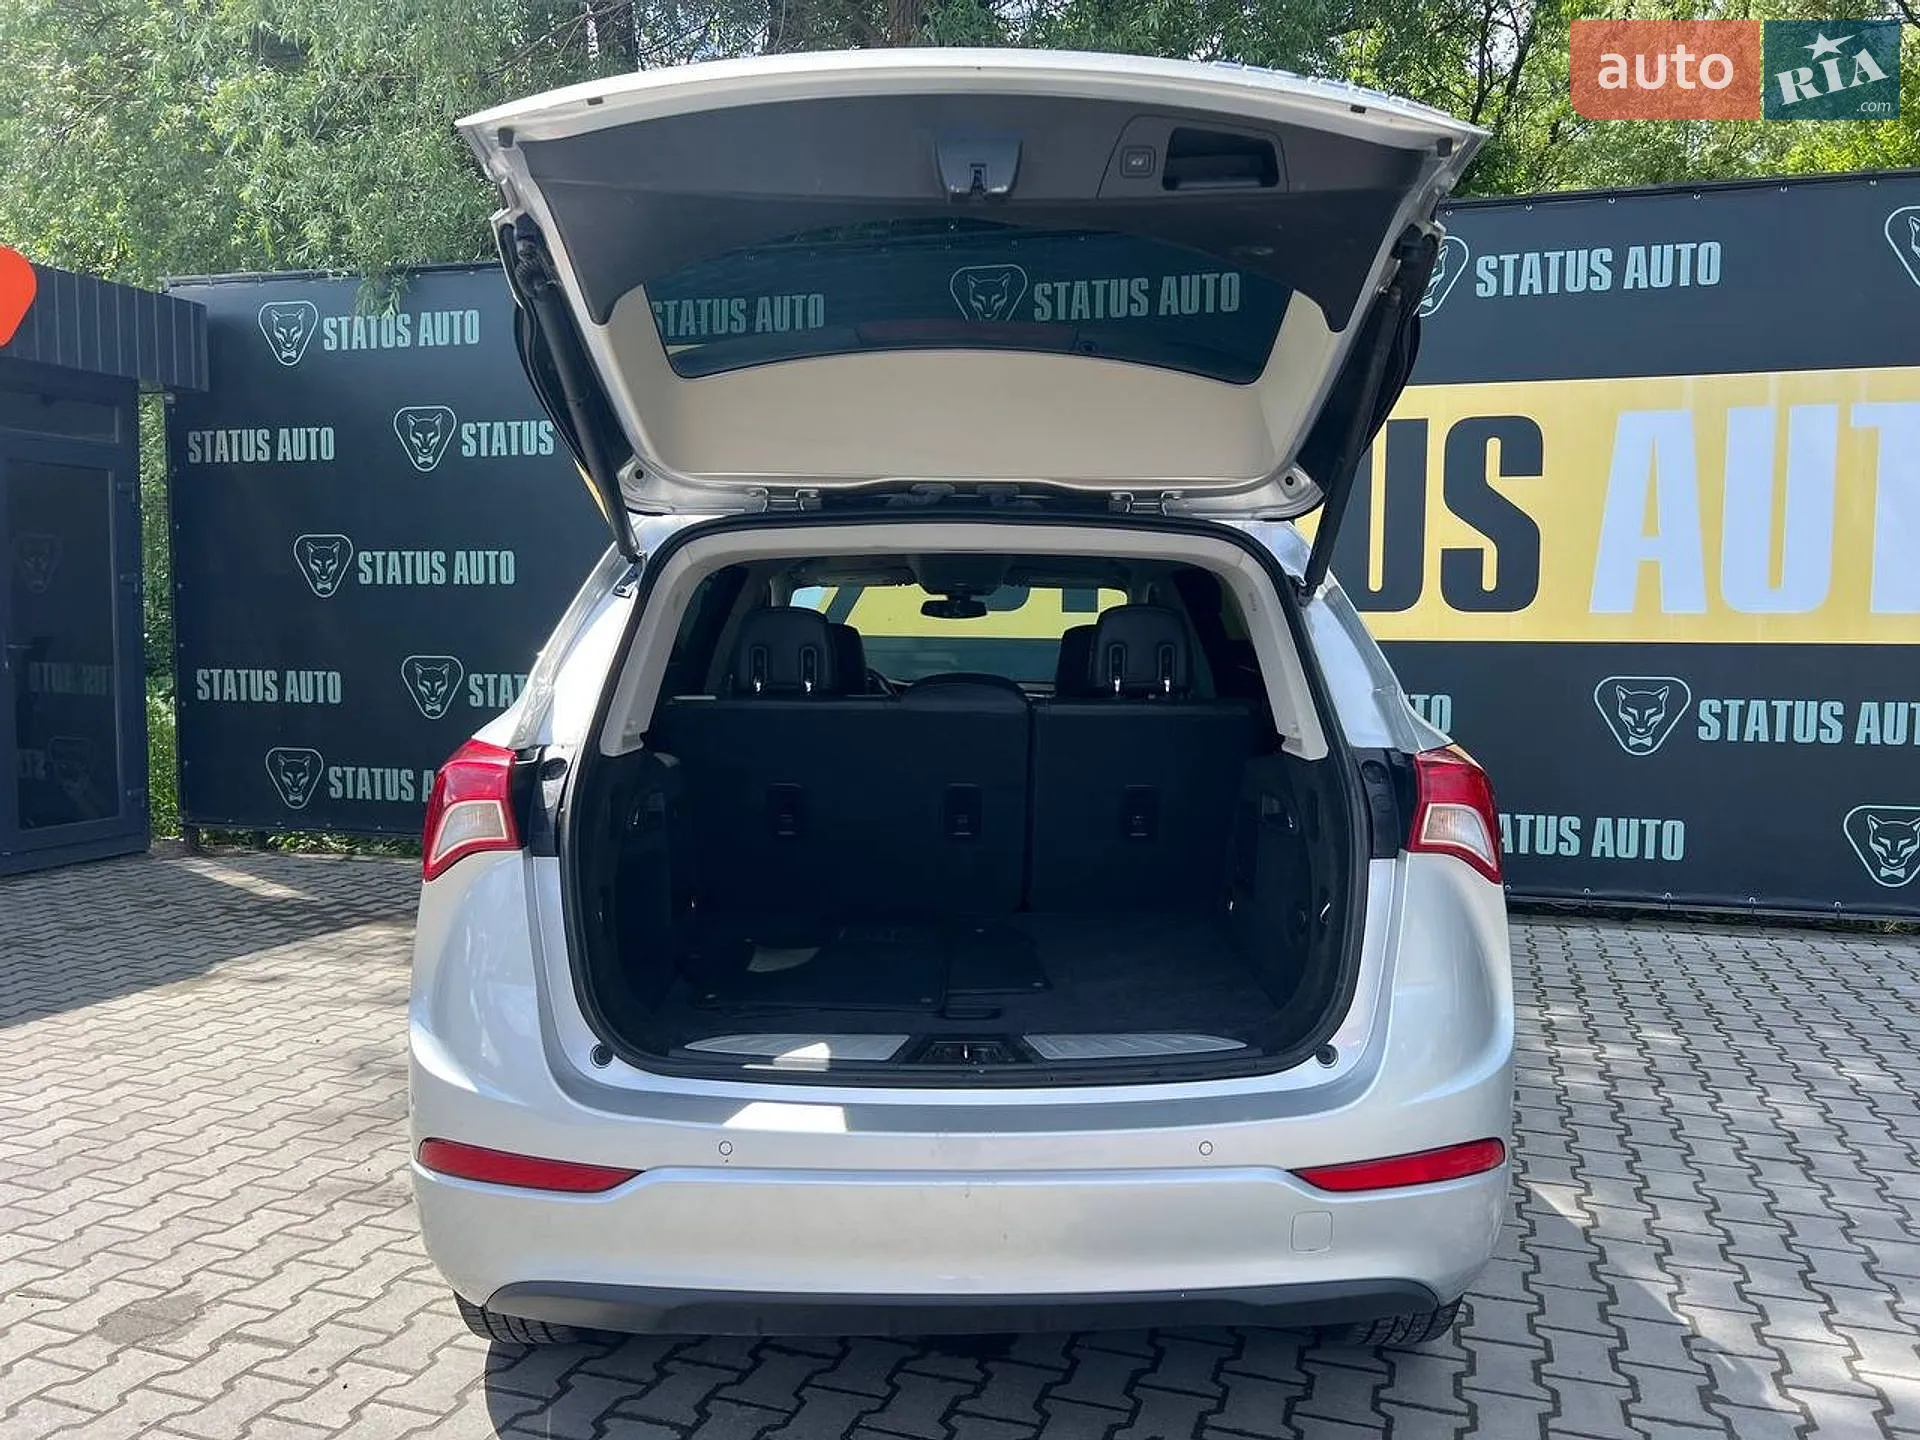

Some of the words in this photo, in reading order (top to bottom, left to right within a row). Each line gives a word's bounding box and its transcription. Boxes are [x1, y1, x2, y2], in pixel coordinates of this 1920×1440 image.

[1475, 247, 1613, 298] STATUS
[1623, 241, 1722, 290] AUTO
[754, 293, 825, 333] AUTO
[1034, 277, 1149, 322] STATUS
[1158, 272, 1241, 316] AUTO
[323, 313, 412, 351] STATUS
[418, 309, 480, 347] AUTO
[188, 428, 271, 464] STATUS
[277, 426, 335, 462] AUTO
[461, 420, 555, 458] STATUS
[358, 550, 447, 585] STATUS
[453, 550, 515, 585] AUTO
[196, 668, 279, 703] STATUS
[284, 670, 342, 705] AUTO
[1698, 699, 1845, 744] STATUS
[328, 766, 415, 802] STATUS
[1591, 817, 1685, 861] AUTO
